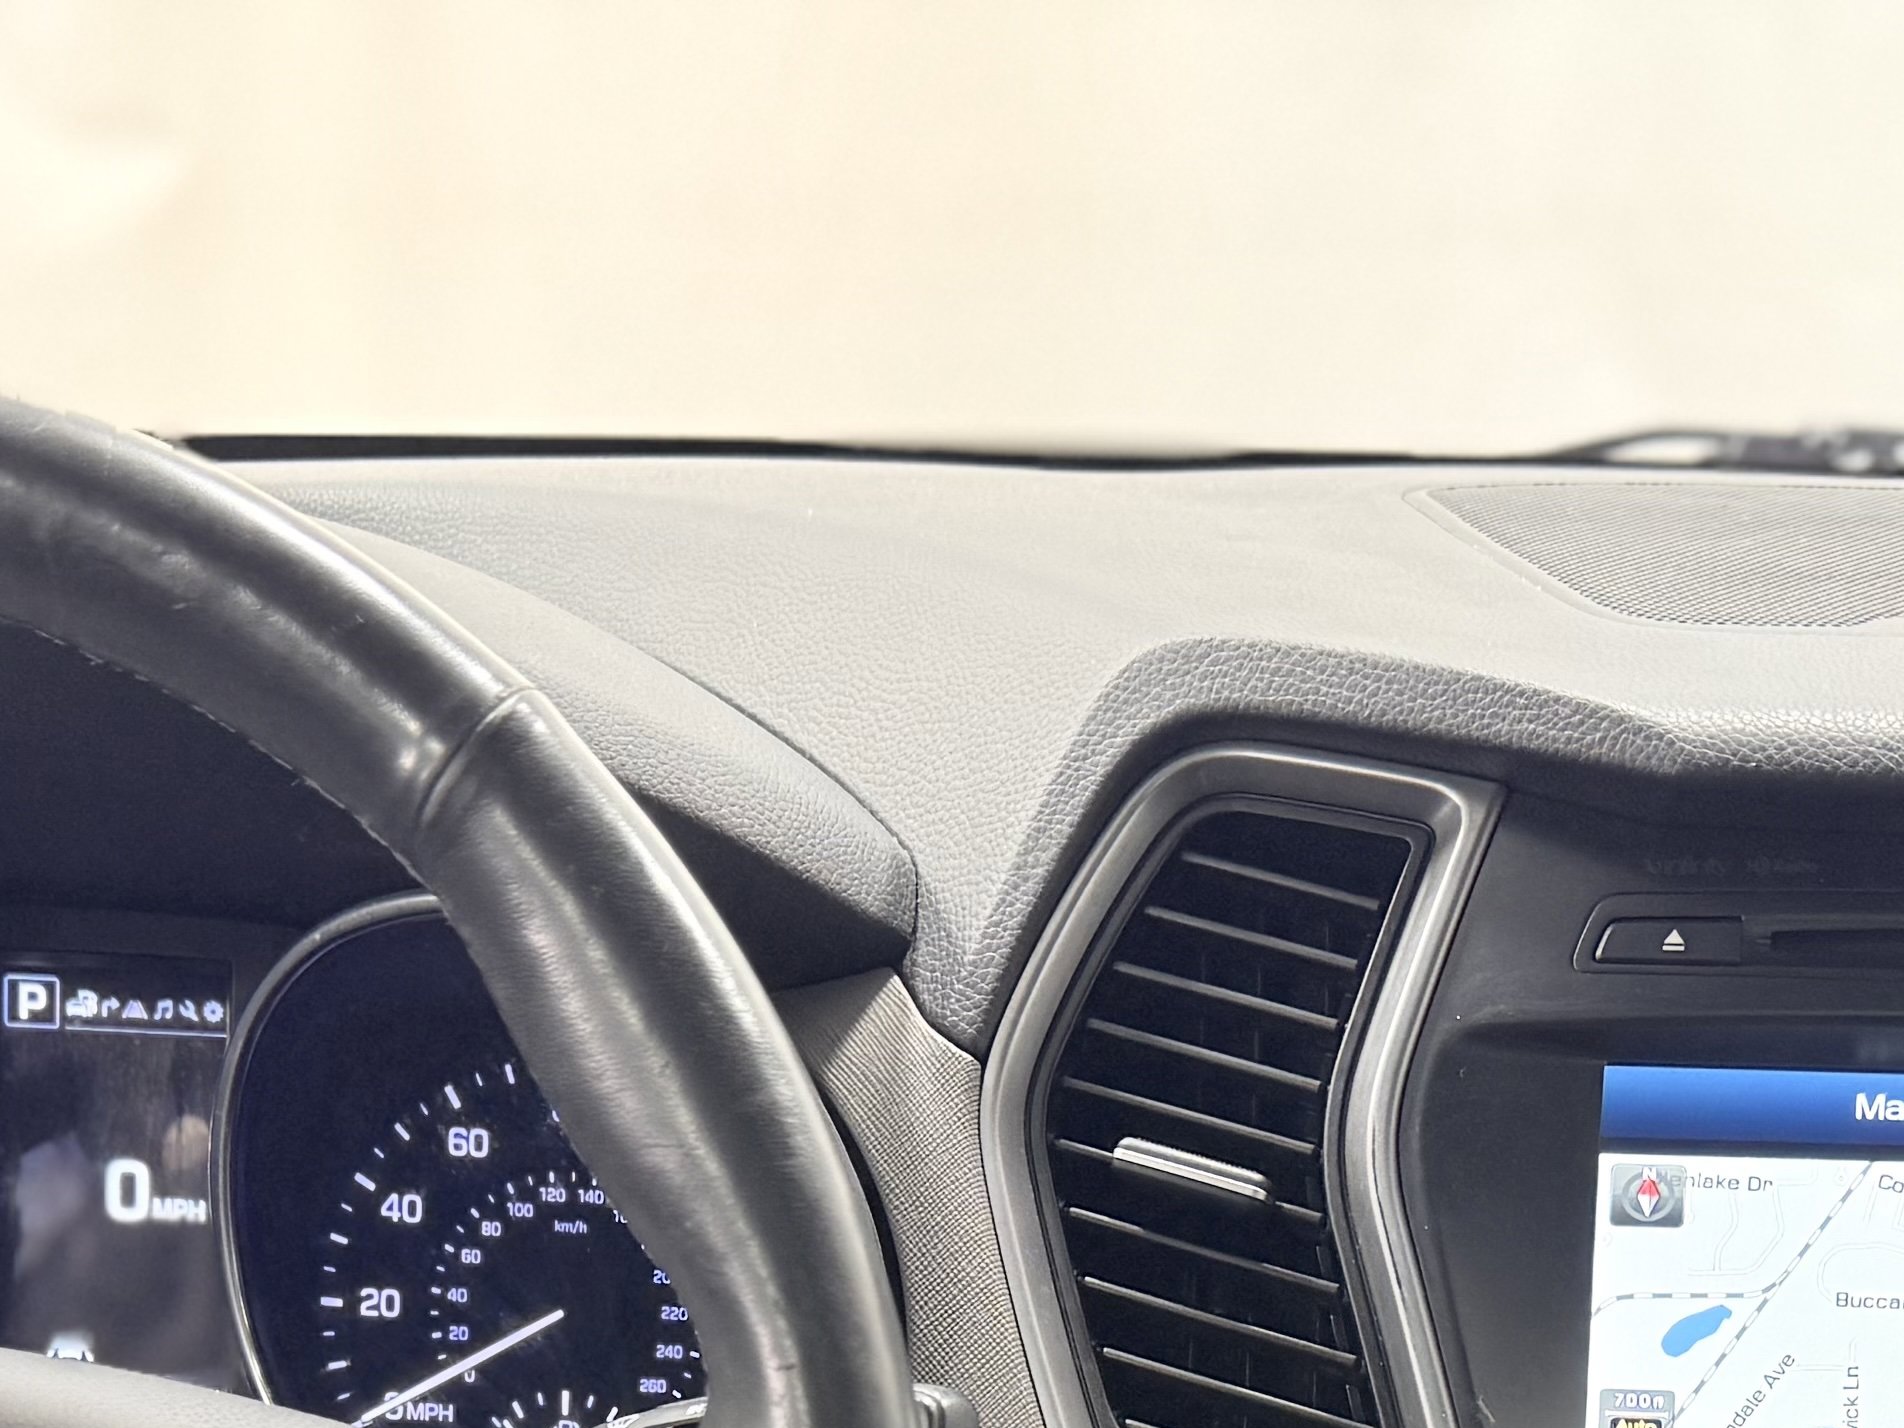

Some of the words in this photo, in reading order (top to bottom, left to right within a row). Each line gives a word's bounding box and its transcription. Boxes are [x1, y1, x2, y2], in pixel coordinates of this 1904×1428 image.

[17, 983, 48, 1018] P
[447, 1127, 488, 1158] 60
[1748, 1176, 1773, 1192] Dr
[105, 1162, 149, 1220] 0
[152, 1198, 206, 1222] MPH
[539, 1188, 567, 1202] 120
[578, 1189, 605, 1205] 140
[380, 1193, 423, 1223] 40
[507, 1203, 533, 1217] 100
[482, 1222, 501, 1237] 80
[554, 1219, 587, 1234] km/h
[461, 1250, 481, 1264] 60
[360, 1288, 400, 1317] 20
[447, 1288, 467, 1303] 40
[661, 1306, 688, 1321] 220
[449, 1326, 468, 1341] 20
[656, 1345, 683, 1360] 240
[1764, 1354, 1795, 1389] Ave
[1844, 1366, 1859, 1390] Ln
[640, 1379, 667, 1394] 260
[407, 1401, 454, 1422] MPH
